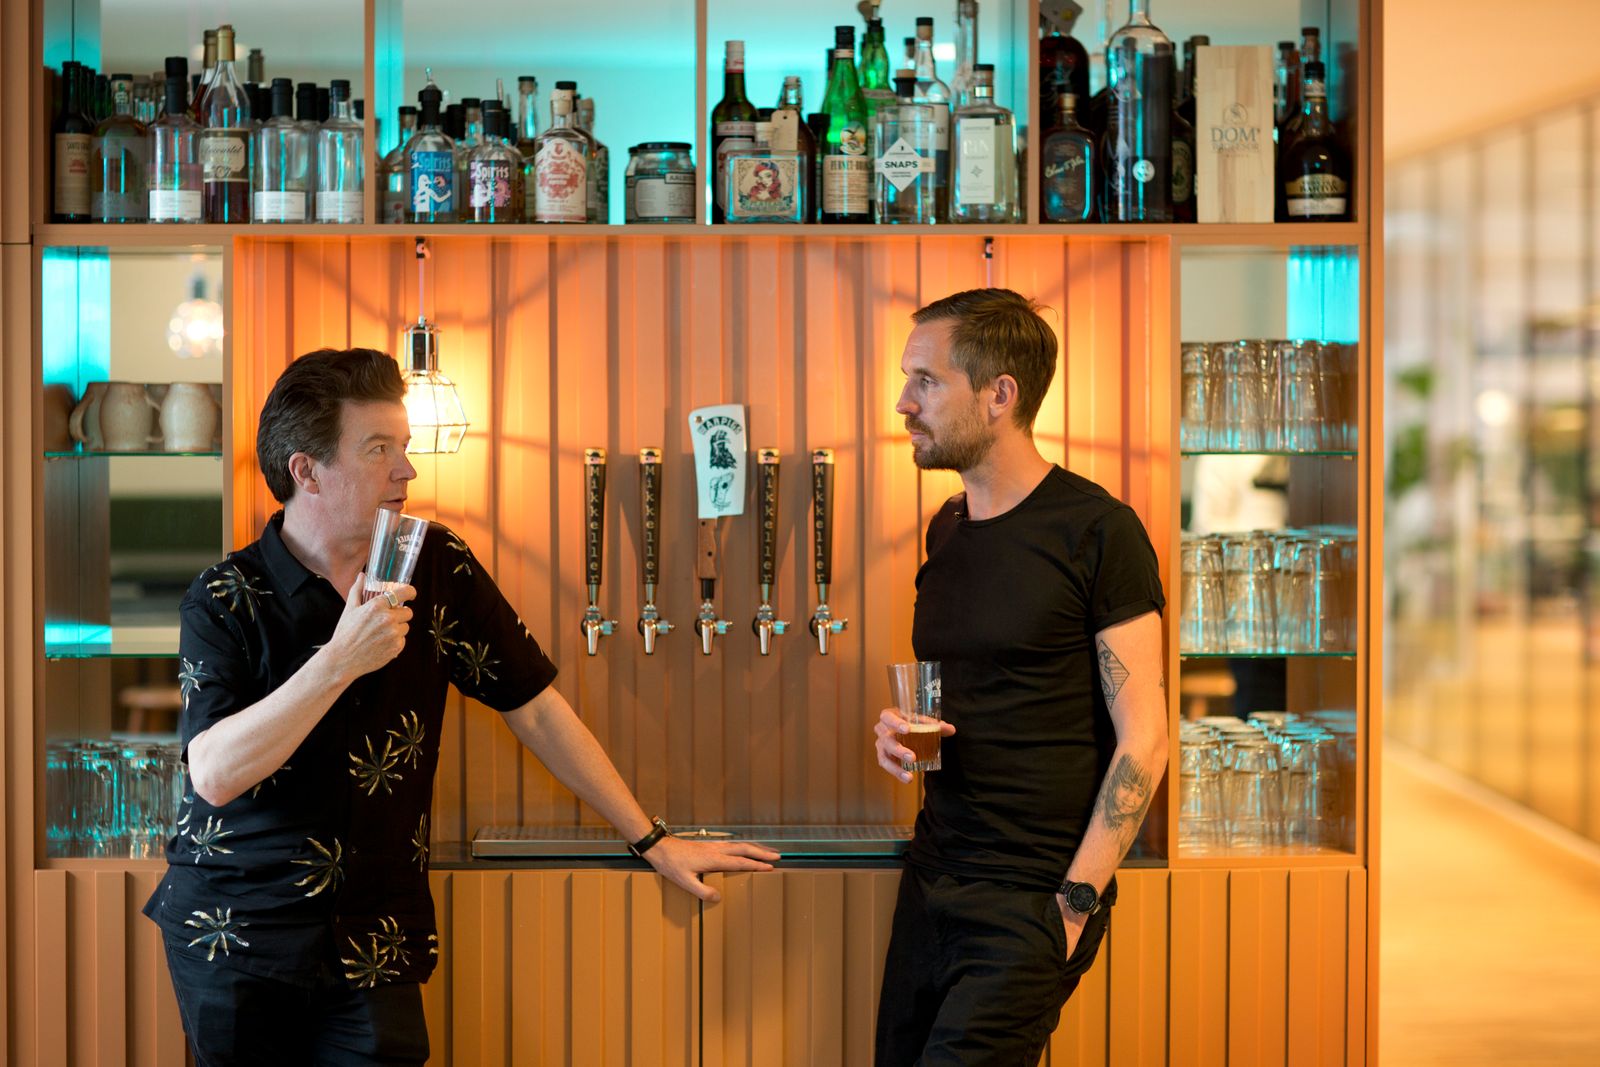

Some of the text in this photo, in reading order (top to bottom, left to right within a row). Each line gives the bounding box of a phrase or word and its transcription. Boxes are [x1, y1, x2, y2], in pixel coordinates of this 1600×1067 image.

[475, 161, 510, 181] Spirits
[884, 161, 918, 169] SNAPS
[590, 465, 601, 584] Mikkeller
[644, 465, 656, 584] Mikkeller
[763, 465, 776, 583] Mikkeller
[815, 465, 825, 583] Mikkeller
